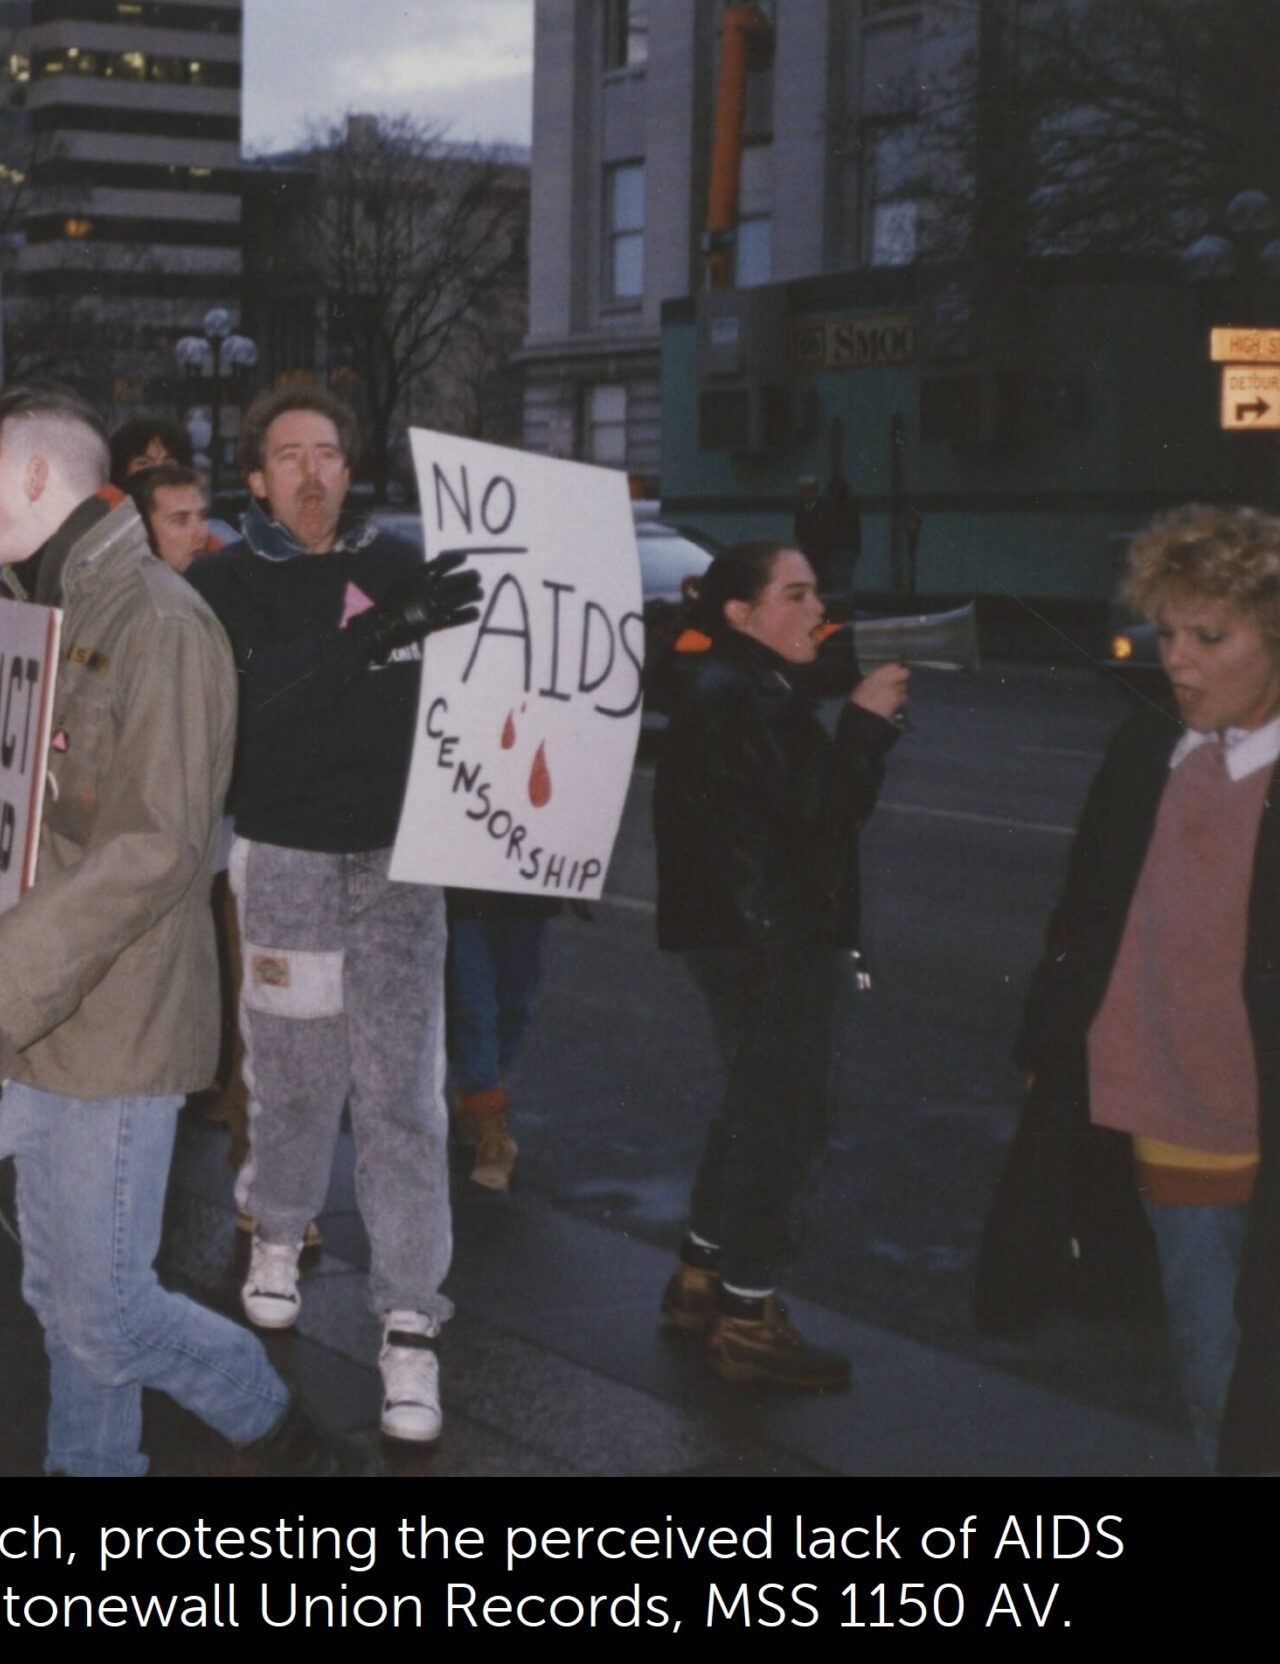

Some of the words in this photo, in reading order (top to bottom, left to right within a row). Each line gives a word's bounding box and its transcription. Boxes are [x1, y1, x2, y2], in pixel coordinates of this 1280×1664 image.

[1230, 337, 1260, 354] HIGH
[431, 462, 516, 536] NO
[461, 573, 645, 719] AIDS
[425, 697, 602, 893] CENSORSHIP
